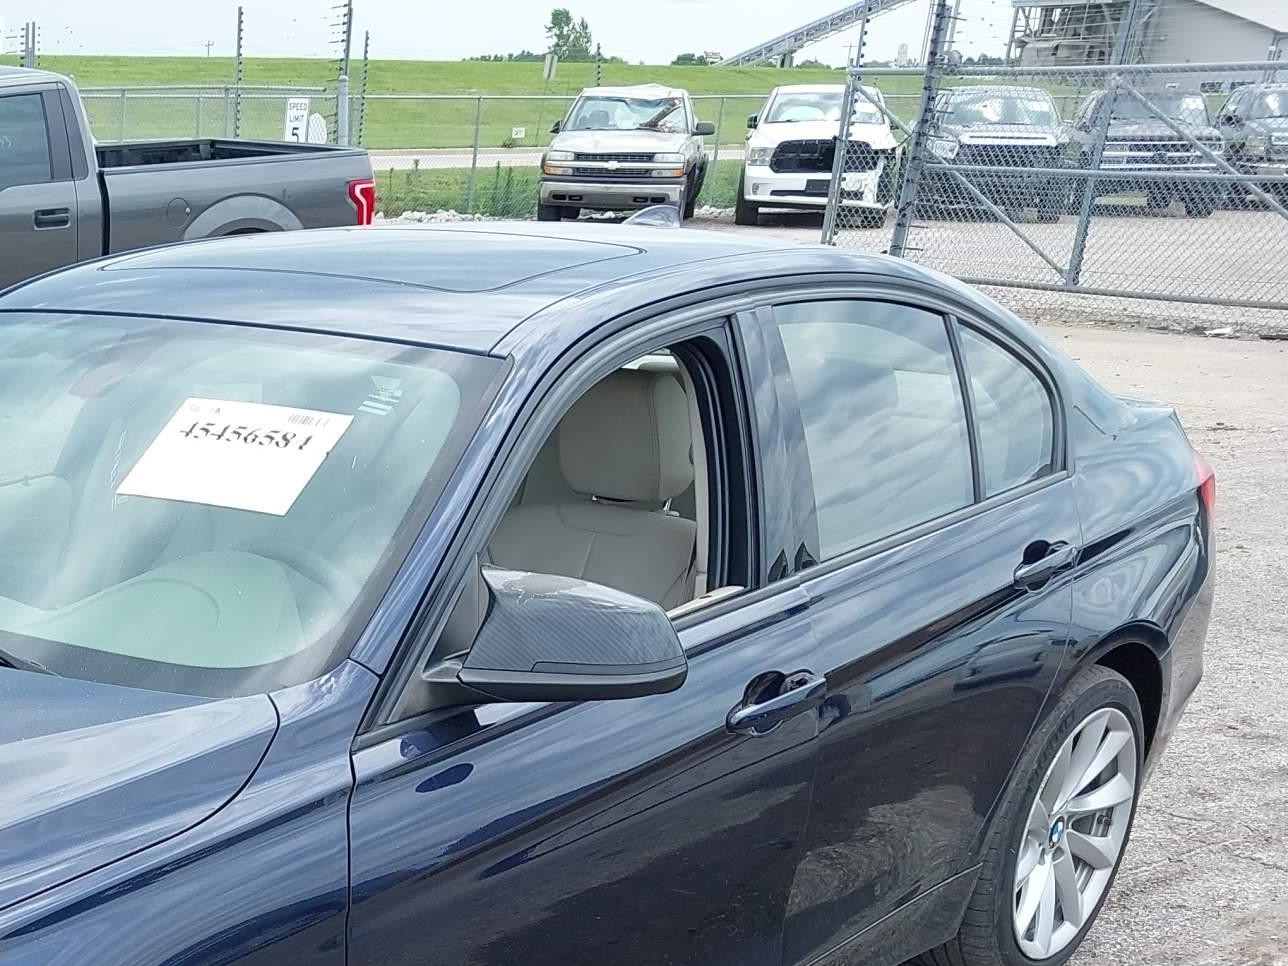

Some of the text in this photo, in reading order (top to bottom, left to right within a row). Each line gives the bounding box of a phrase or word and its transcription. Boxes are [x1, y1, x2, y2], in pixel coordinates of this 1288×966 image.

[288, 102, 308, 111] SPEED
[289, 114, 305, 123] LIMIT
[291, 126, 300, 143] 5
